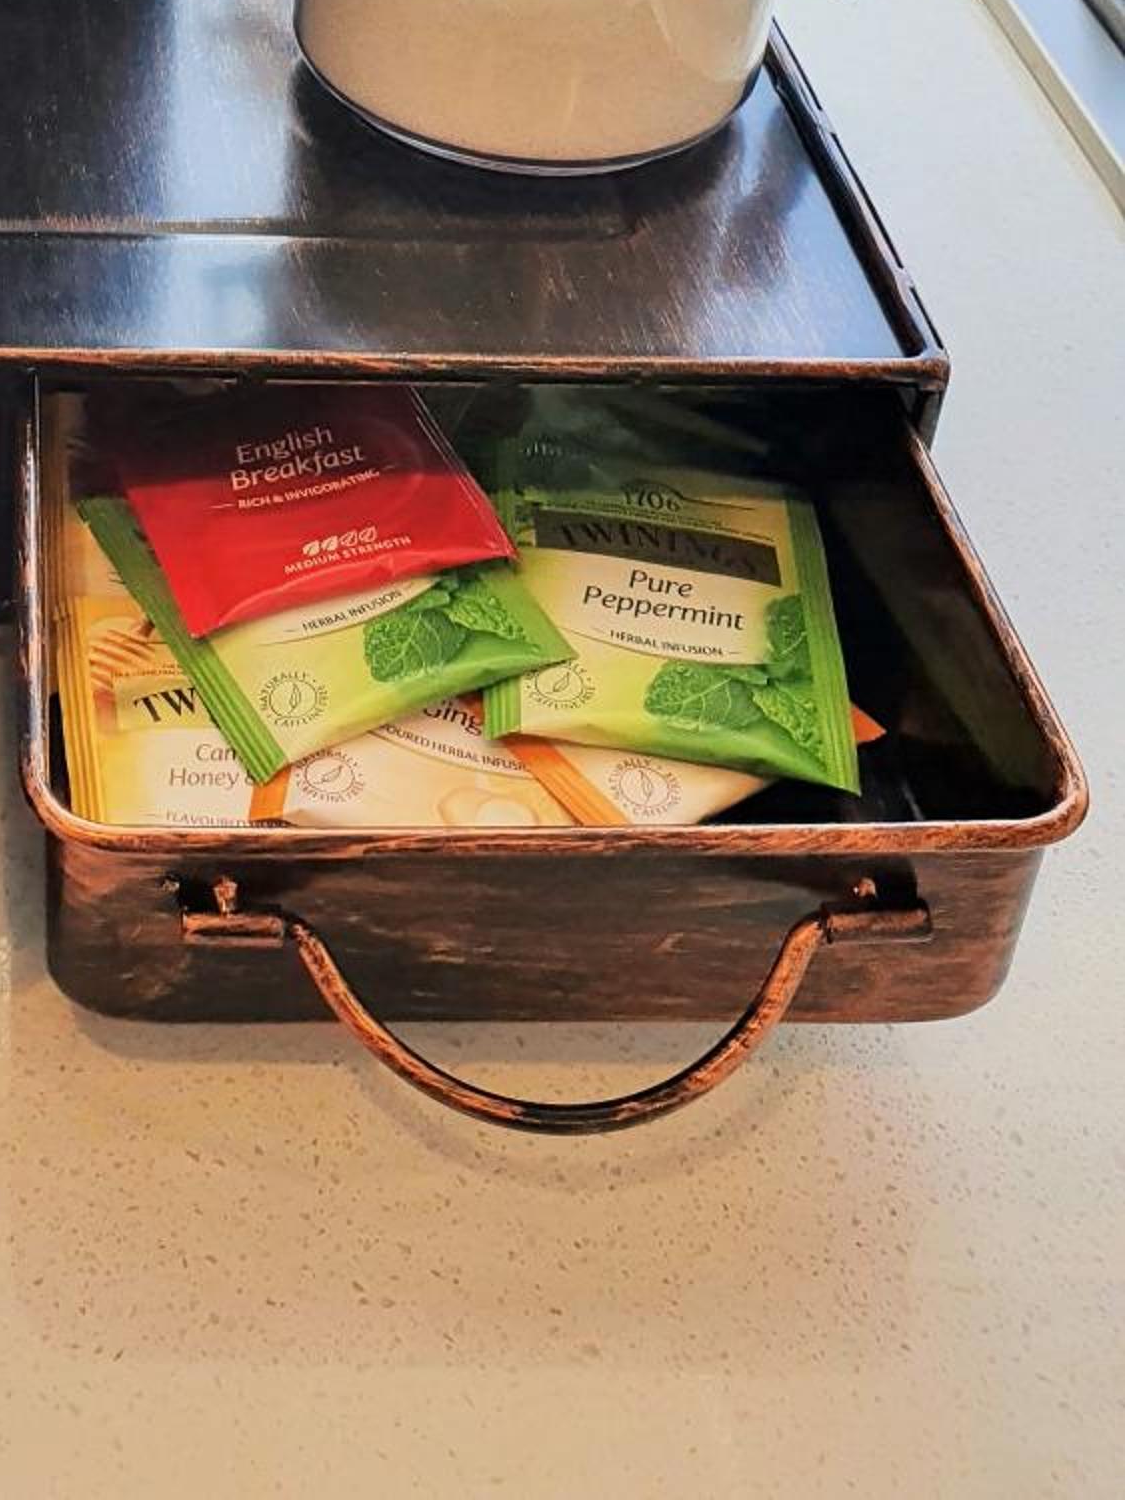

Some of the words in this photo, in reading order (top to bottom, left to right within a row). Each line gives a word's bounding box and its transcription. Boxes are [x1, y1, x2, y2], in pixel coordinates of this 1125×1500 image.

[237, 426, 333, 465] English
[230, 445, 365, 491] Breakfast
[238, 494, 273, 509] RICH
[284, 467, 381, 502] INVIGORATING
[283, 548, 341, 574] MEDIUM
[342, 535, 412, 559] STRENGTH
[629, 568, 694, 598] Pure
[302, 611, 347, 632] HERBAL
[347, 589, 403, 618] INFUSION
[582, 585, 745, 631] Peppermint
[609, 629, 658, 648] HERBAL
[660, 640, 724, 657] INFUSION
[432, 740, 479, 764] HERBAL
[169, 766, 240, 791] Honey
